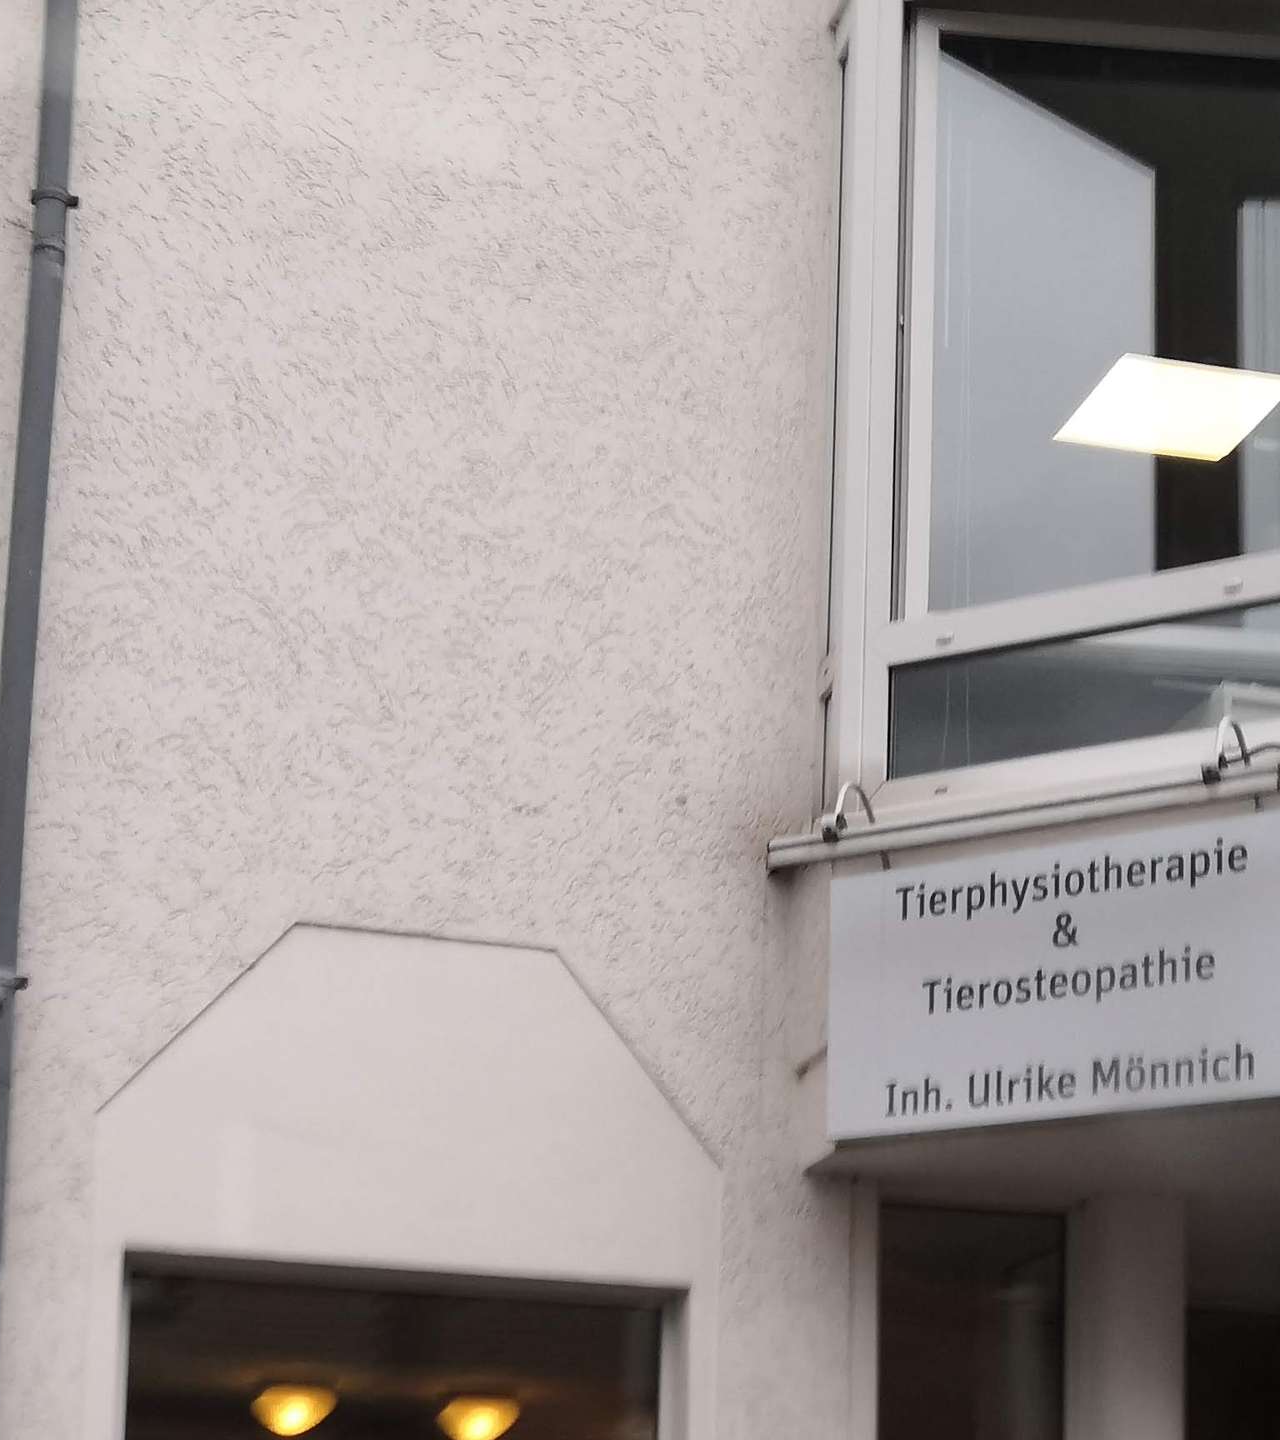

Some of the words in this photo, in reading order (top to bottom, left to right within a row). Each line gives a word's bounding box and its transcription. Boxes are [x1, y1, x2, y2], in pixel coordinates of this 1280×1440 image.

[895, 836, 1249, 922] Tierphysiotherapie
[1051, 912, 1079, 949] &
[922, 945, 1216, 1016] Tierosteopathie
[885, 1077, 954, 1119] Inh.
[968, 1064, 1077, 1110] Ulrike
[1092, 1043, 1256, 1097] Mönnich
